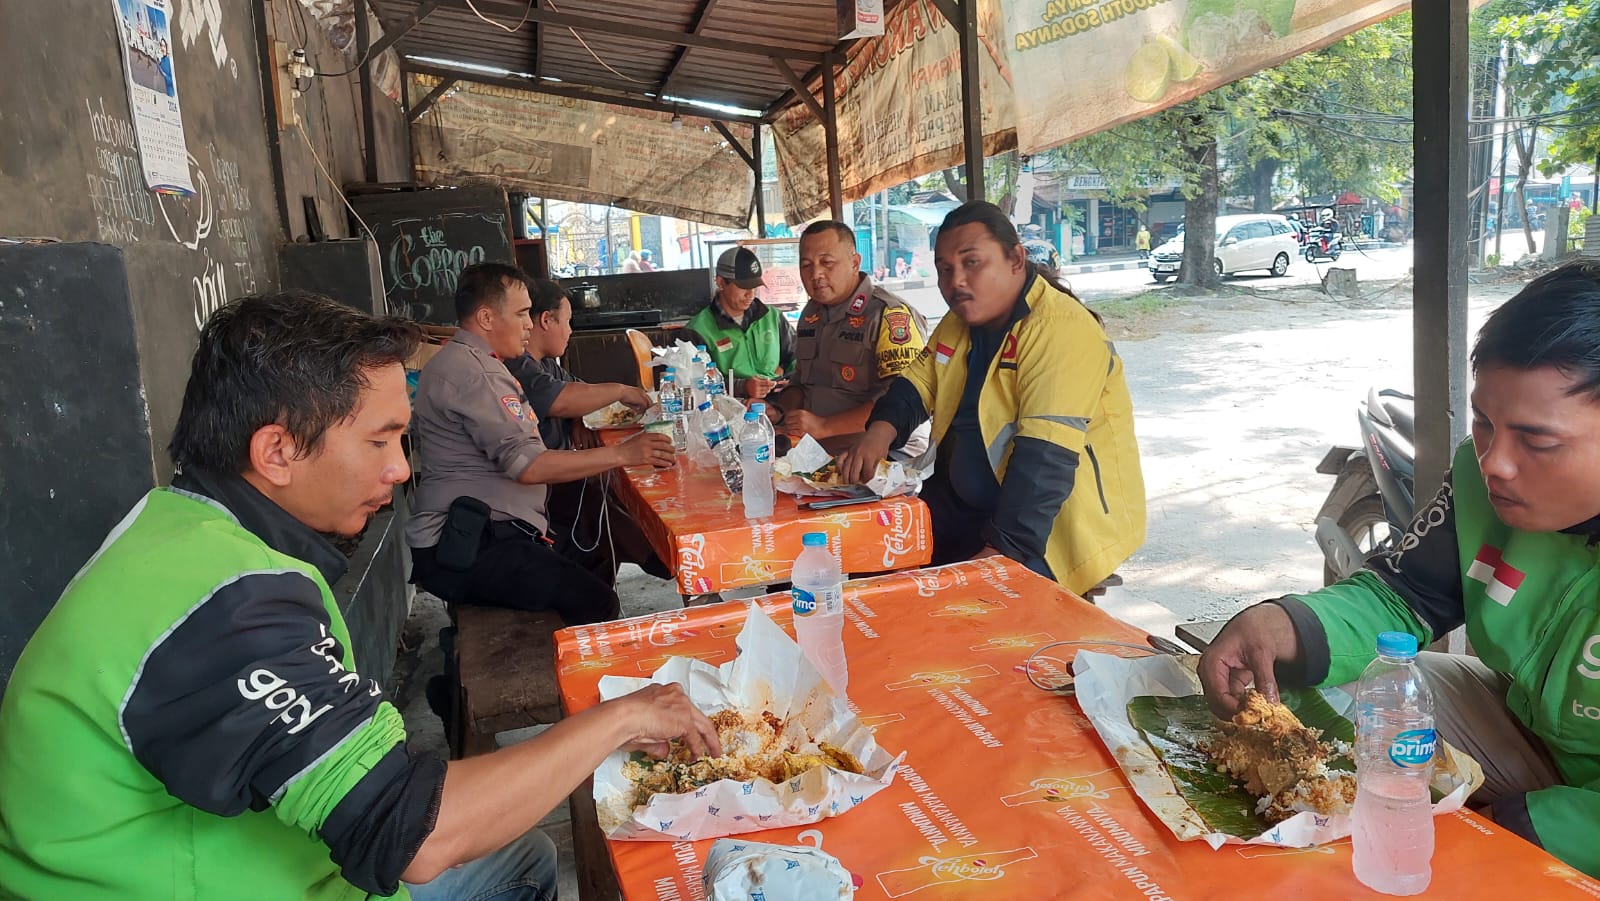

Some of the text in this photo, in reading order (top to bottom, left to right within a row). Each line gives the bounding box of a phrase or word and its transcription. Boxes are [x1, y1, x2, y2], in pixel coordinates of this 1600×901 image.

[896, 764, 978, 849] APAPUN MAKANANNYA
[1056, 804, 1128, 867] MAKANANNYA
